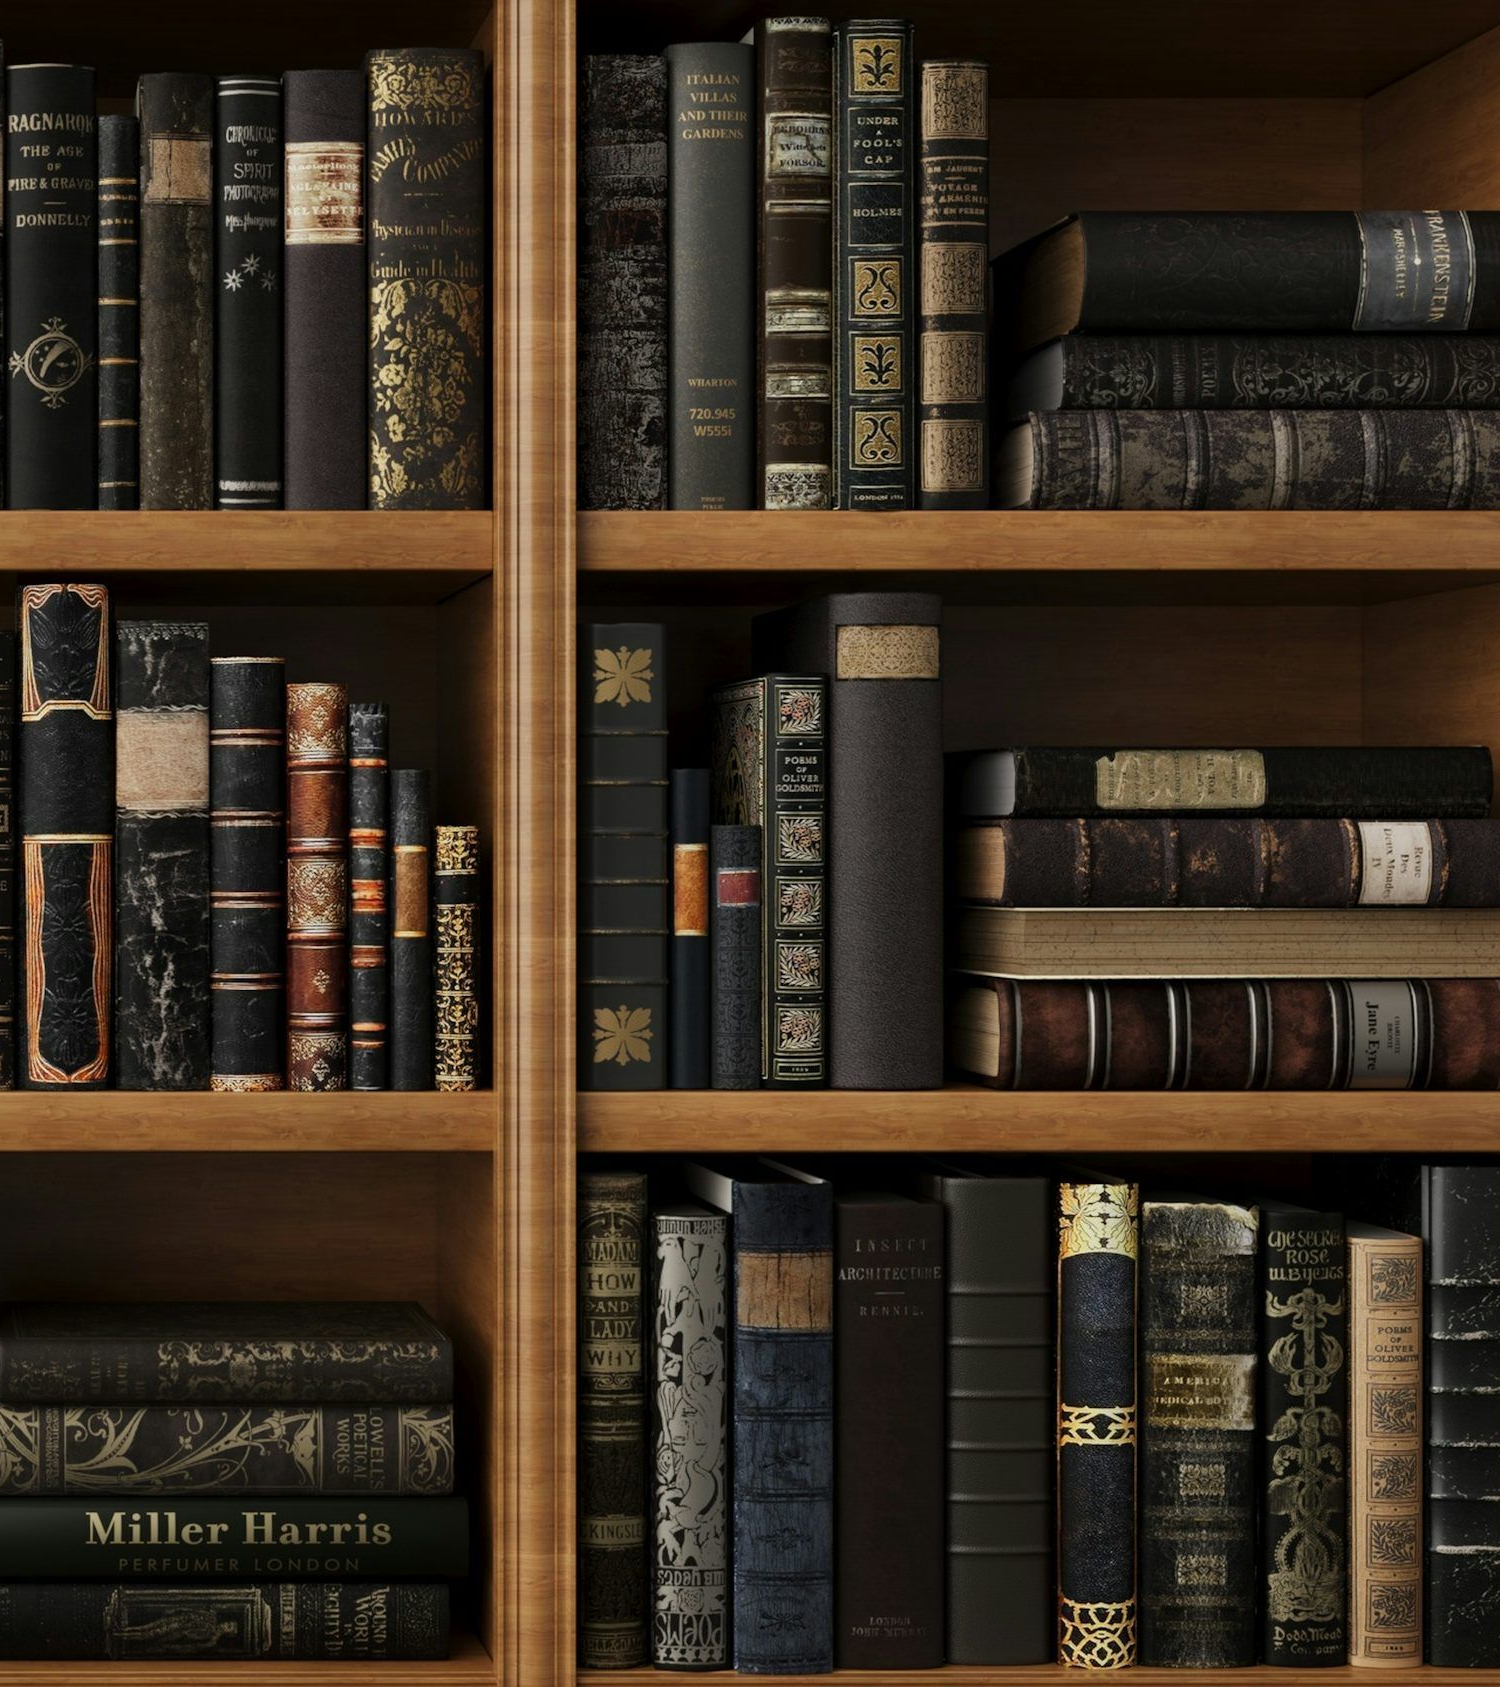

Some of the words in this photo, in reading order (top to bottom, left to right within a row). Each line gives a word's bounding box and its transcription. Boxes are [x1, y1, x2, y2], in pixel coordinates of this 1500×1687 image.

[685, 73, 740, 86] ITALIAN
[690, 91, 738, 104] VILLAS
[677, 110, 706, 122] AND
[708, 110, 749, 123] THEIR
[856, 116, 900, 126] UNDER
[682, 128, 745, 141] GARDENS
[853, 138, 903, 149] FOOL'S
[19, 144, 51, 158] THE
[56, 144, 84, 158] AGE
[246, 148, 259, 158] OF
[863, 154, 894, 165] CAP
[46, 162, 63, 172] OF
[233, 162, 275, 181] SPIRIT
[7, 177, 38, 192] FIRE
[852, 207, 903, 218] HOLMES
[15, 213, 92, 228] DONNELLY
[1422, 208, 1451, 324] FRANKENSTEIN
[687, 378, 738, 389] WHARTON
[688, 407, 737, 421] 720.945
[692, 424, 733, 438] W555i
[784, 755, 818, 766] POEMS
[795, 766, 807, 774] OF
[782, 774, 819, 784] OLIVER
[1206, 770, 1216, 796] VOL.
[775, 783, 824, 794] GOLDSMITH
[1382, 828, 1394, 855] Deux
[1371, 856, 1382, 869] IV
[1400, 853, 1411, 875] Des
[1413, 846, 1424, 879] Revue
[1382, 859, 1396, 900] Mondes
[1365, 1001, 1380, 1036] Jane
[1364, 1039, 1381, 1072] Eyre
[585, 1240, 638, 1261] MADAM
[854, 1238, 928, 1252] INSECT
[837, 1266, 943, 1281] ARCHITECTURE
[587, 1271, 637, 1291] HOW
[595, 1299, 631, 1314] AND
[589, 1319, 637, 1339] LADY
[1376, 1326, 1413, 1335] POEMS
[1389, 1336, 1403, 1344] OF
[1373, 1344, 1415, 1354] OLIVER
[586, 1349, 638, 1367] WHY
[1367, 1354, 1419, 1363] GOLDSMITH
[332, 1417, 351, 1474] WORKS
[352, 1412, 368, 1483] POETICAL
[368, 1406, 385, 1490] LOWELL'S
[85, 1511, 230, 1545] Miller
[240, 1511, 393, 1546] Harris
[118, 1557, 240, 1572] PERFUMER
[253, 1557, 360, 1572] LONDON
